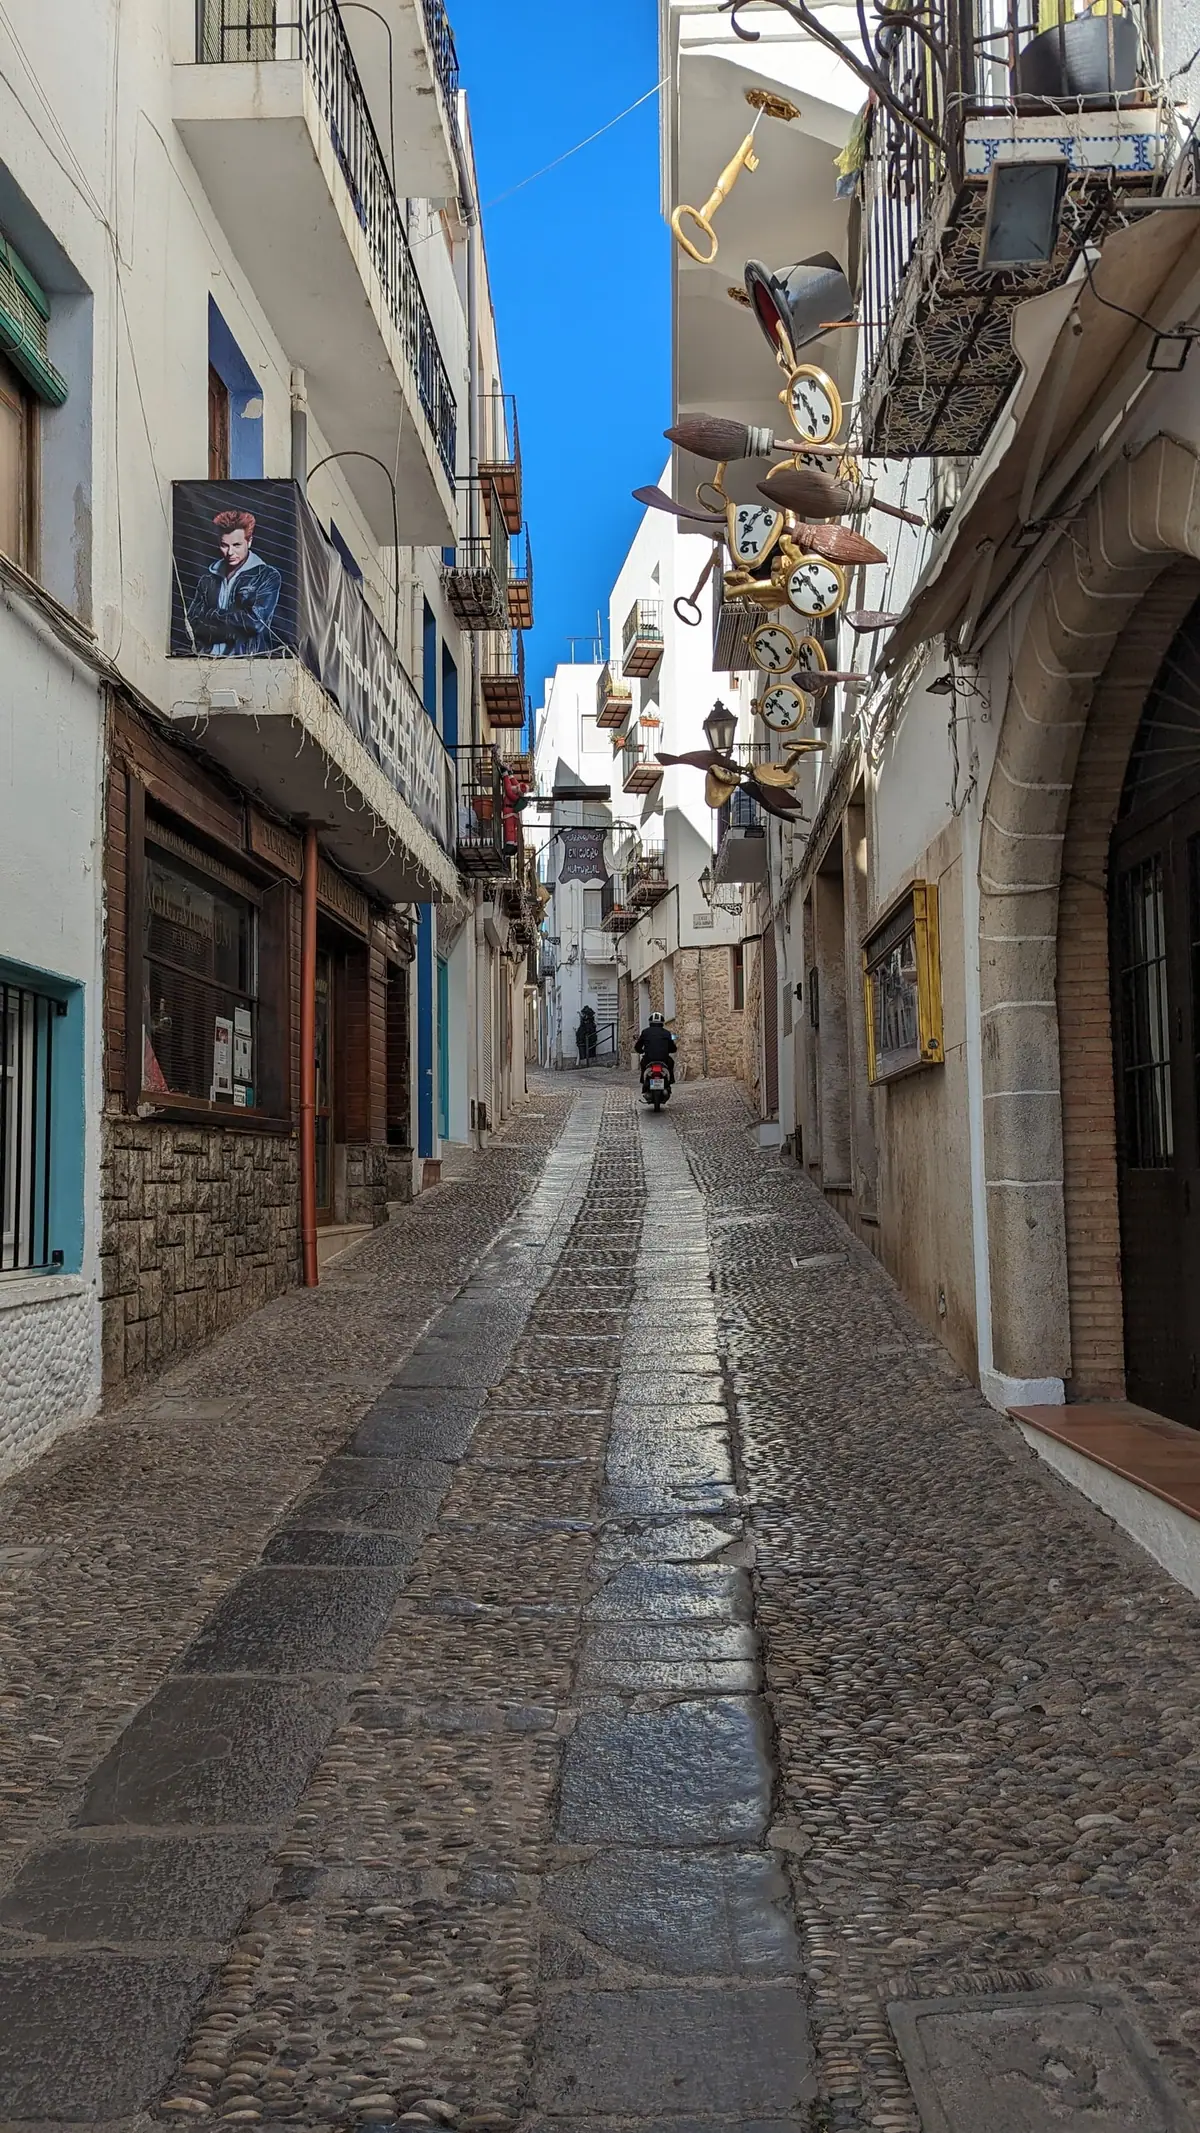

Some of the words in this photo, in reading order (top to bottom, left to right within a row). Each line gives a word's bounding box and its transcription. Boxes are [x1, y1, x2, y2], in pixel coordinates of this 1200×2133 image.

[740, 541, 759, 554] 12
[808, 564, 819, 576] 3
[791, 576, 803, 594] 12
[335, 620, 370, 692] MEJOR
[765, 702, 774, 717] 12
[263, 824, 296, 867] TICKETS
[568, 848, 577, 858] EN
[579, 848, 599, 859] CUERO
[567, 864, 600, 874] NATURAL
[317, 864, 343, 907] AGIC
[343, 887, 367, 925] SHOP
